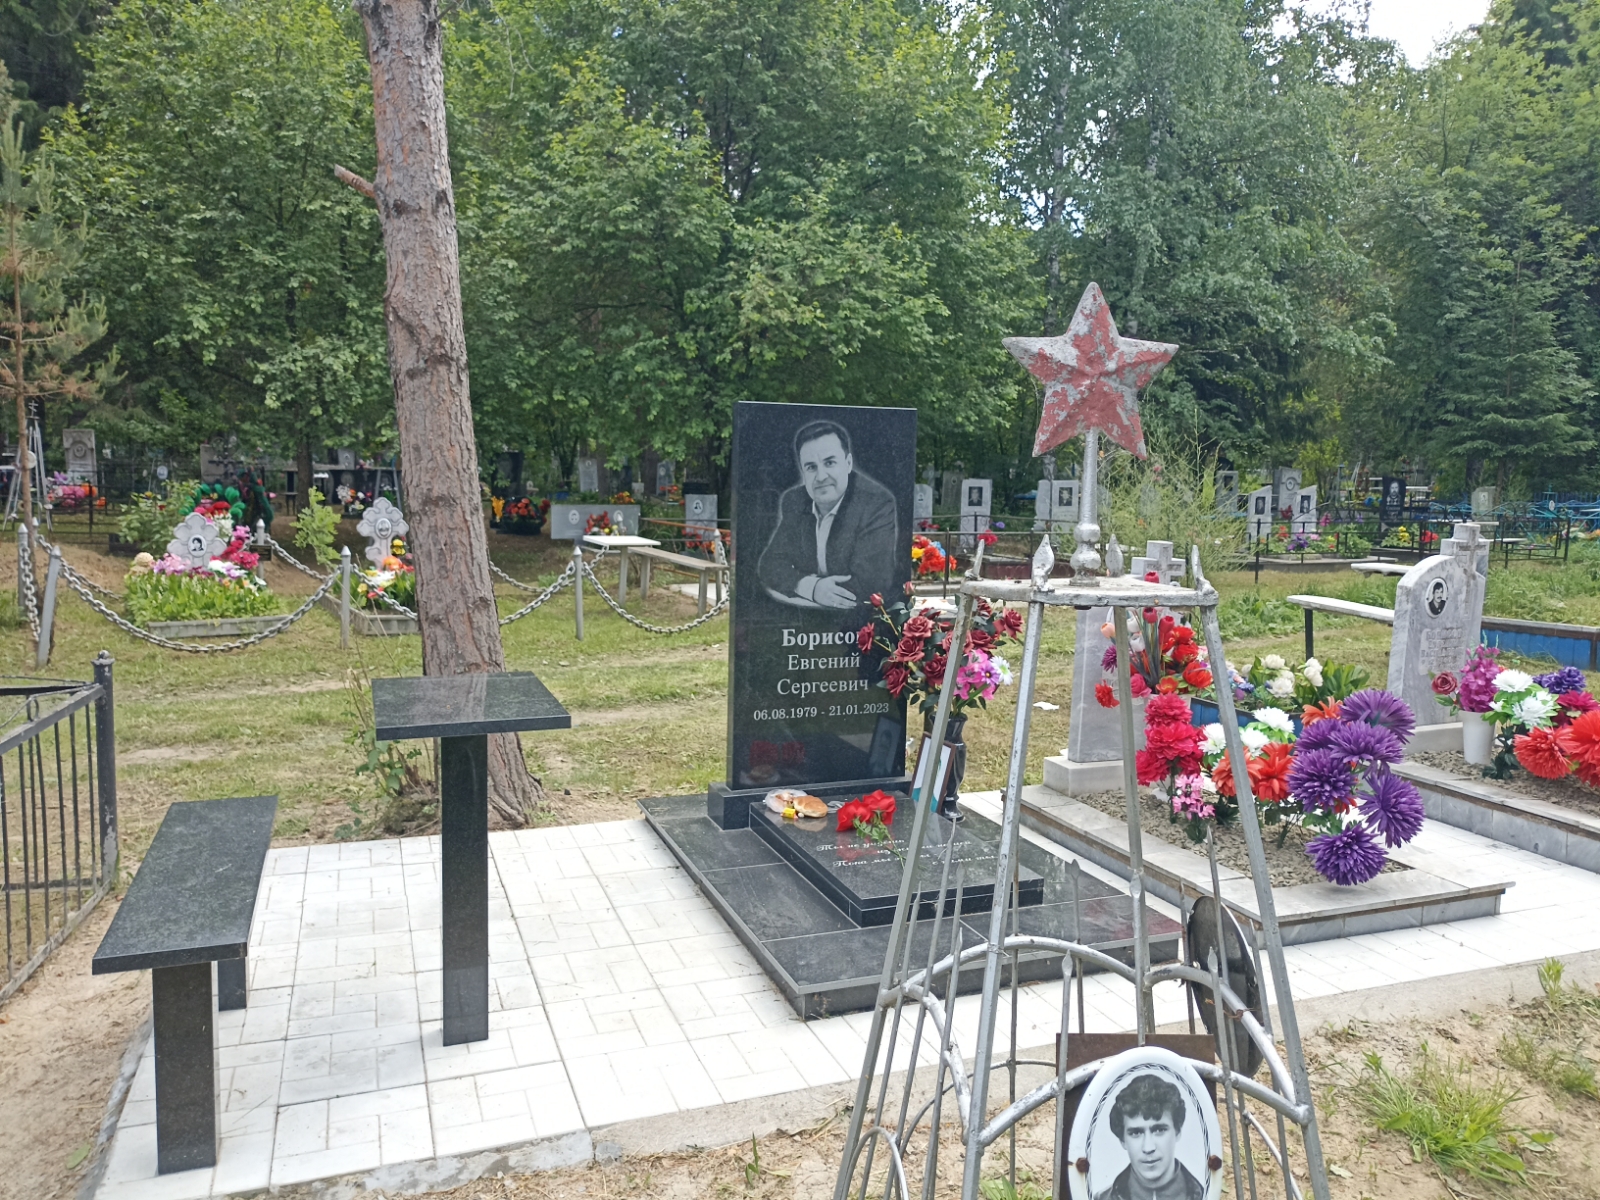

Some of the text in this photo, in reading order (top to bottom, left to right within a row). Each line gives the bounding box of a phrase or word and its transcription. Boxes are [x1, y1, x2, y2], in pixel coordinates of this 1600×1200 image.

[787, 652, 860, 671] Евгений
[777, 678, 869, 698] Сергеевич
[753, 706, 817, 721] 06.08.1979
[829, 702, 889, 717] 21.01.2023
